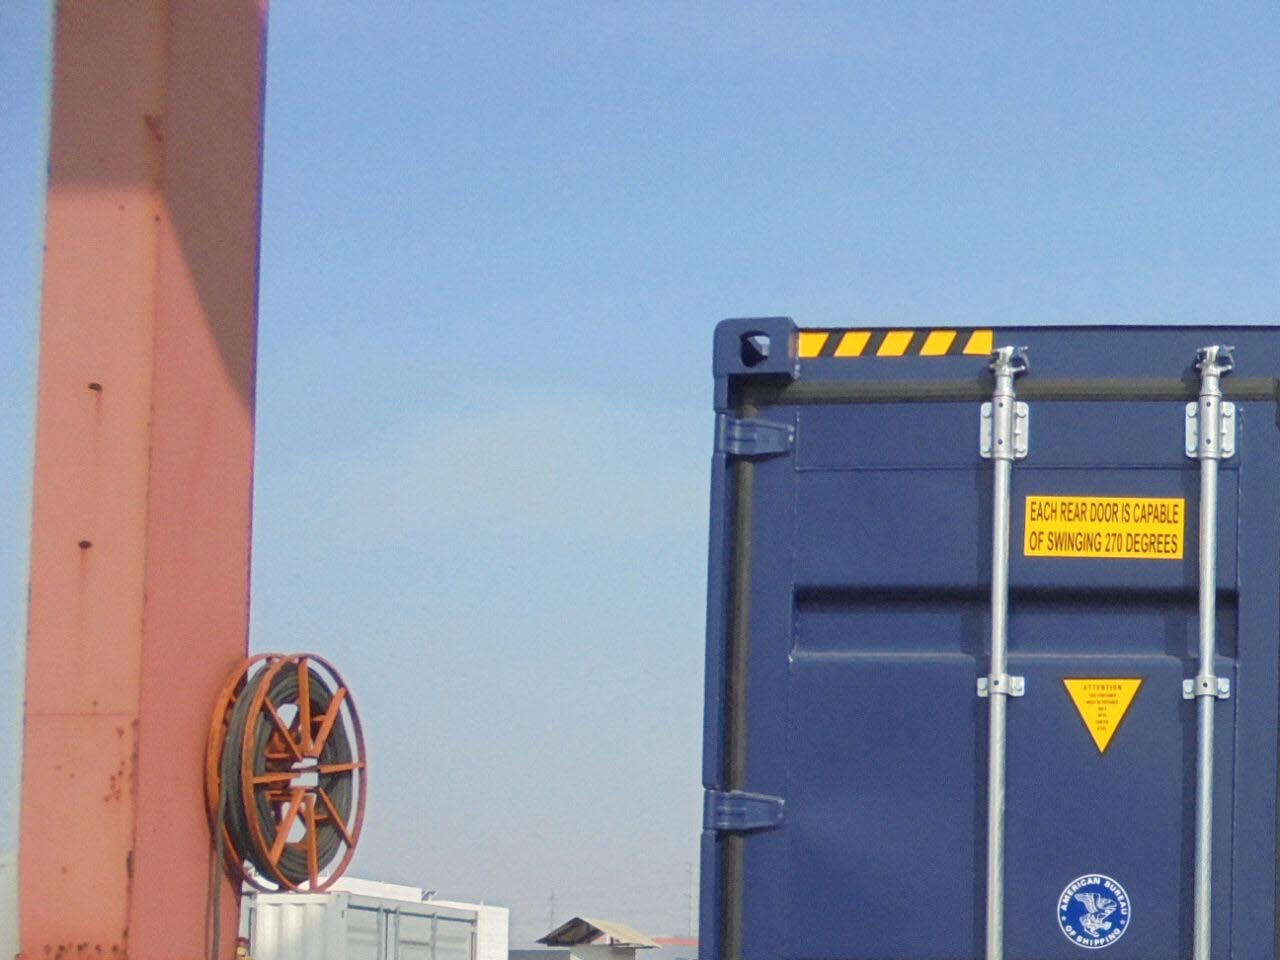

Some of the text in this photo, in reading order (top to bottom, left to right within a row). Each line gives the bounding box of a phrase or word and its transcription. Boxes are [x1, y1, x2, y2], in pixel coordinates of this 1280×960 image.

[1030, 501, 1179, 524] EACH REAR DOOR IS CAPABLE
[1029, 531, 1178, 553] OF SWINGING 270 DEGREES
[1060, 877, 1128, 915] AMERICAN BUREAU
